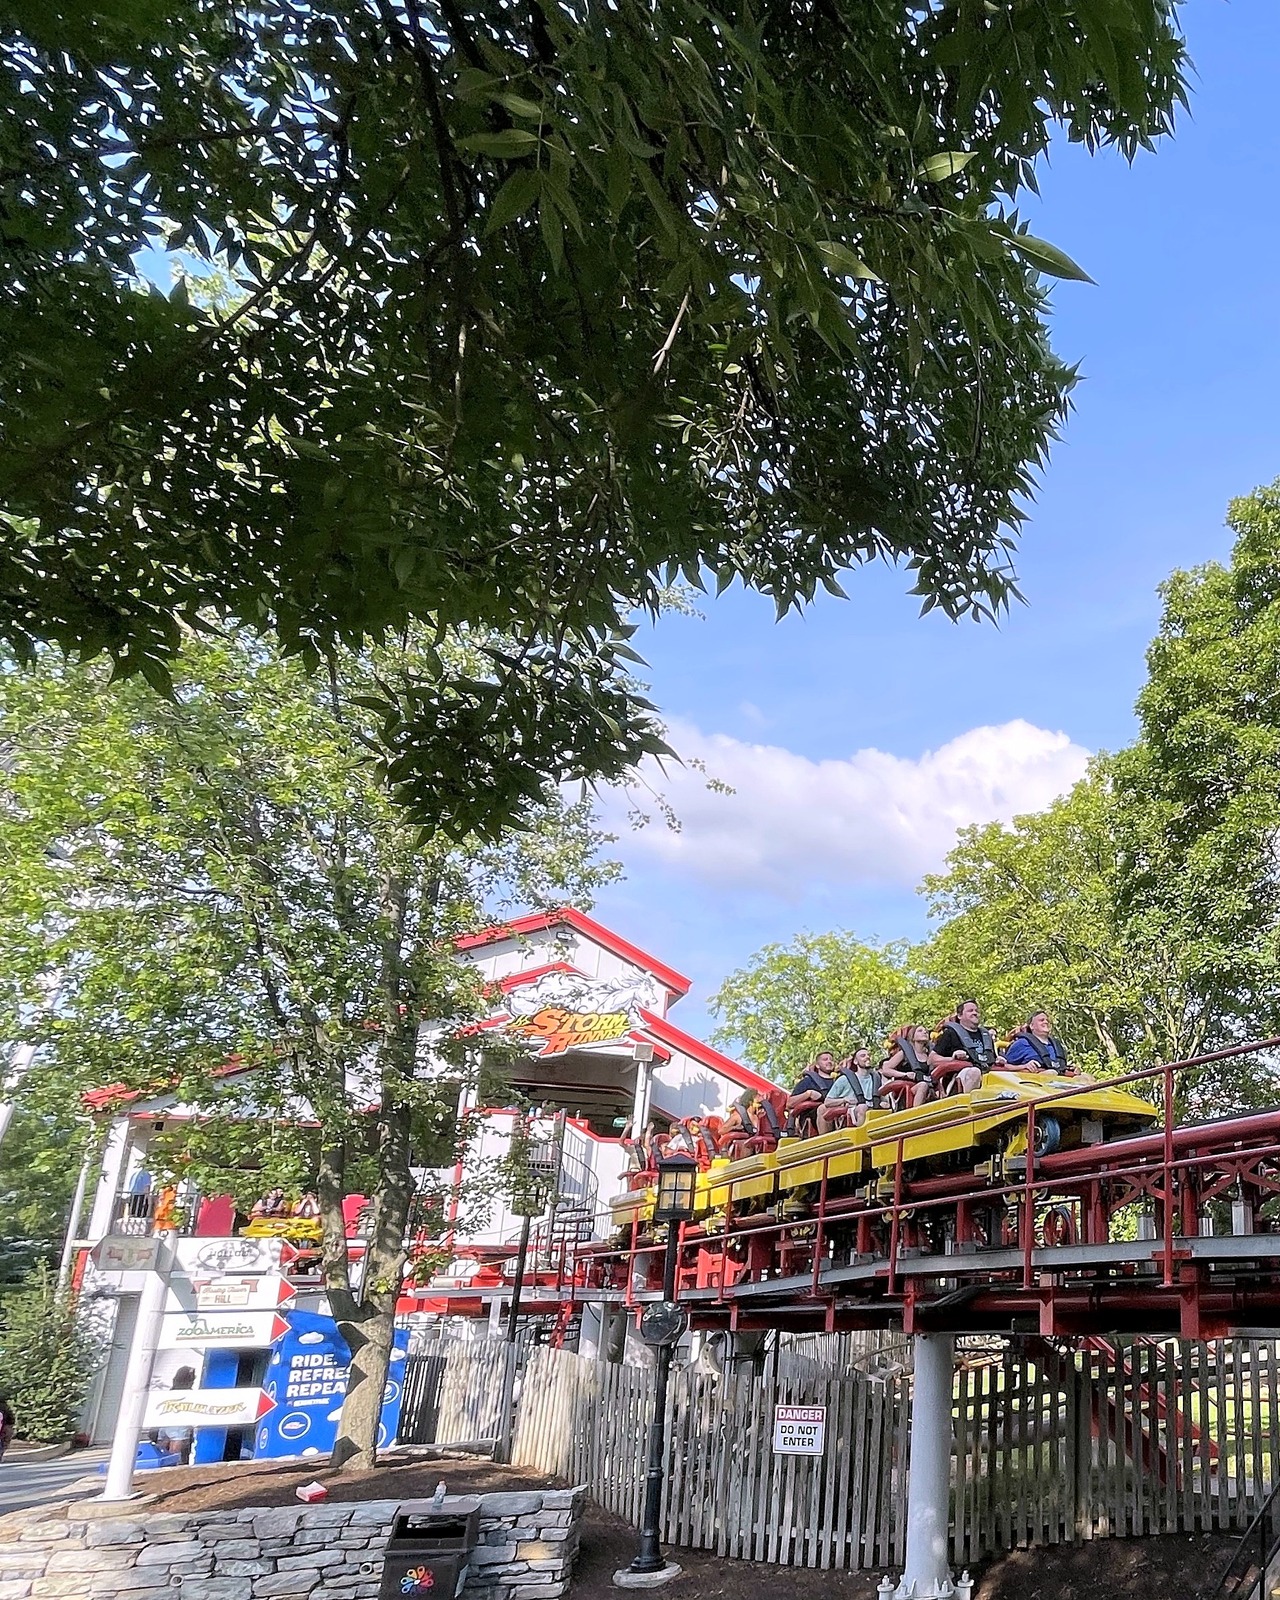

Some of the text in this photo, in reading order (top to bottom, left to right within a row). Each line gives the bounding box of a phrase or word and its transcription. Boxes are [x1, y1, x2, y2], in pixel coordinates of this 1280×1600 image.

[523, 1008, 630, 1036] STORM
[540, 1029, 626, 1056] RUNNER
[291, 1354, 338, 1368] RIDE.
[288, 1367, 351, 1382] REFRES
[286, 1383, 348, 1398] REPEA
[778, 1409, 822, 1420] DANGER
[781, 1425, 818, 1435] DO NOT
[783, 1437, 814, 1447] ENTER
